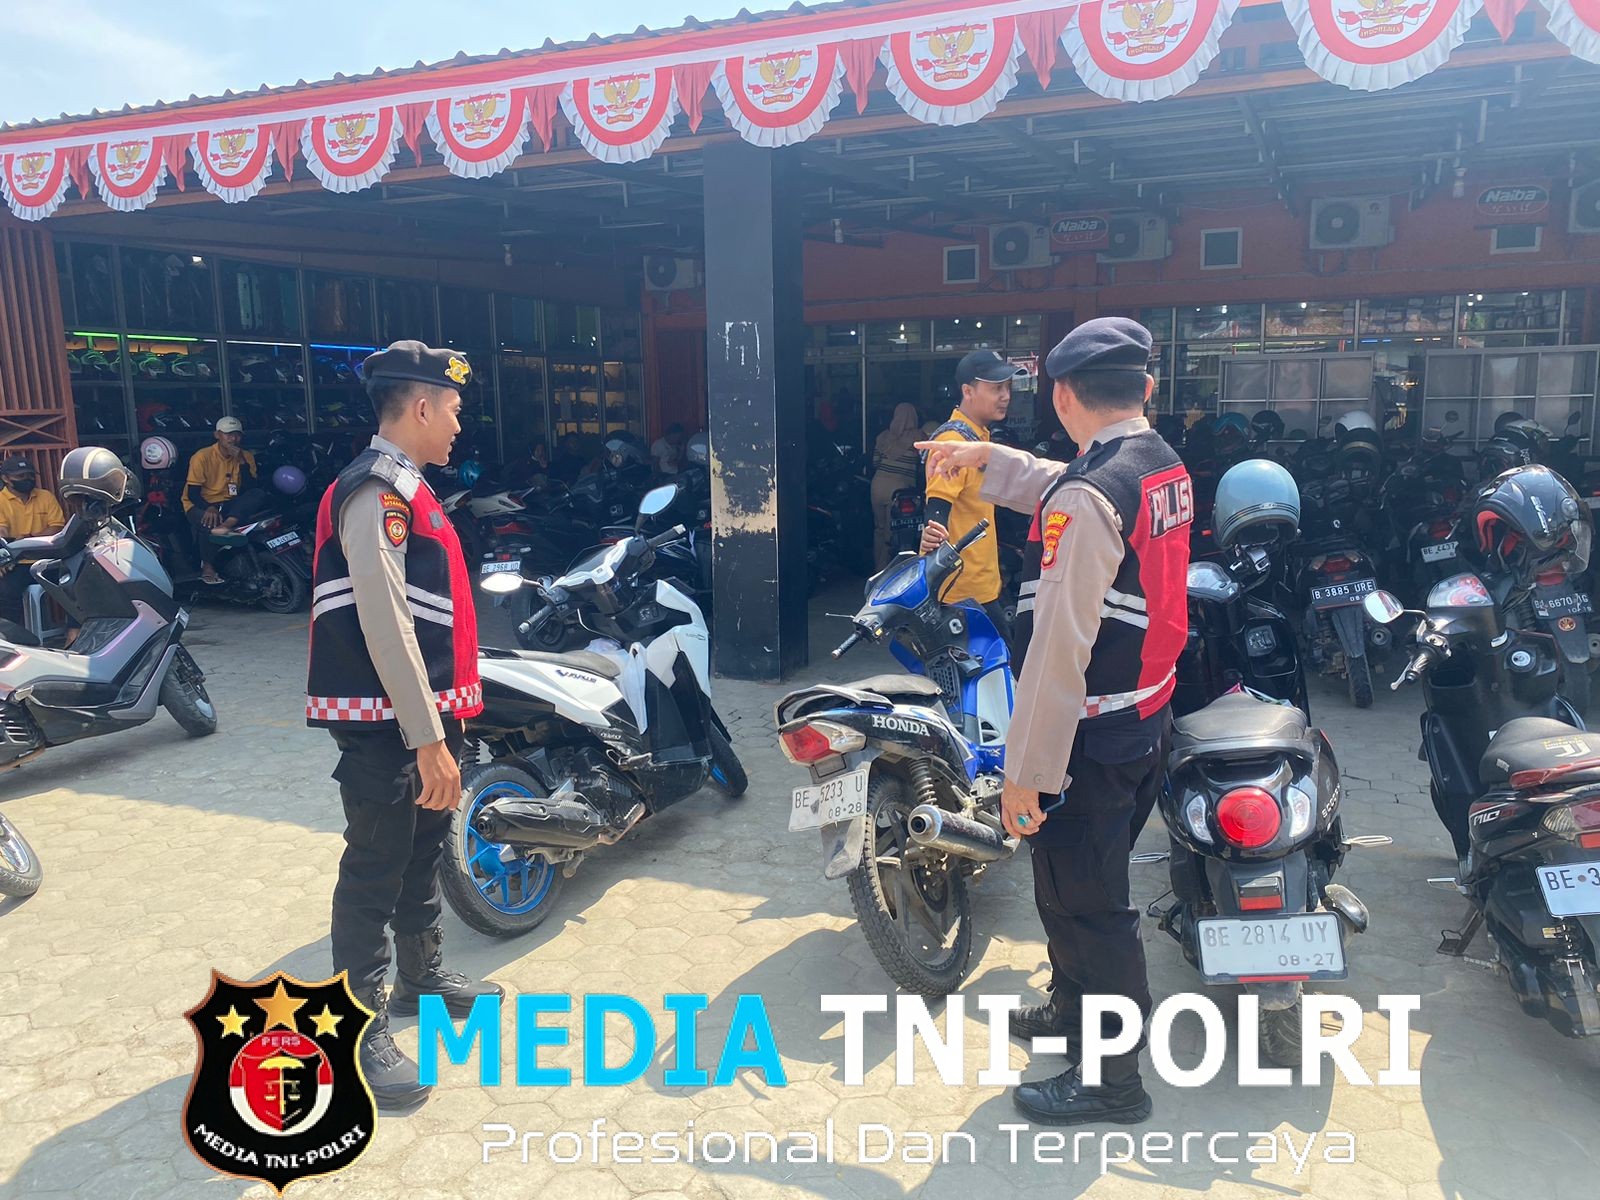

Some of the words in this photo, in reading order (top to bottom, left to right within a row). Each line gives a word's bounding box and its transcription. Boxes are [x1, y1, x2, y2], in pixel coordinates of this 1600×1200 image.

[1485, 189, 1536, 203] Naiba
[1058, 219, 1098, 232] Naiba
[1314, 591, 1321, 599] B
[1324, 586, 1350, 597] 3885
[1354, 581, 1374, 592] URE
[1548, 596, 1573, 608] 6670
[871, 714, 931, 737] HONDA
[795, 790, 810, 808] BE
[819, 780, 844, 804] 5233
[855, 775, 863, 793] U
[1544, 869, 1575, 891] BE
[1203, 926, 1230, 947] BE
[1241, 923, 1291, 945] 2814
[1302, 921, 1328, 942] UY
